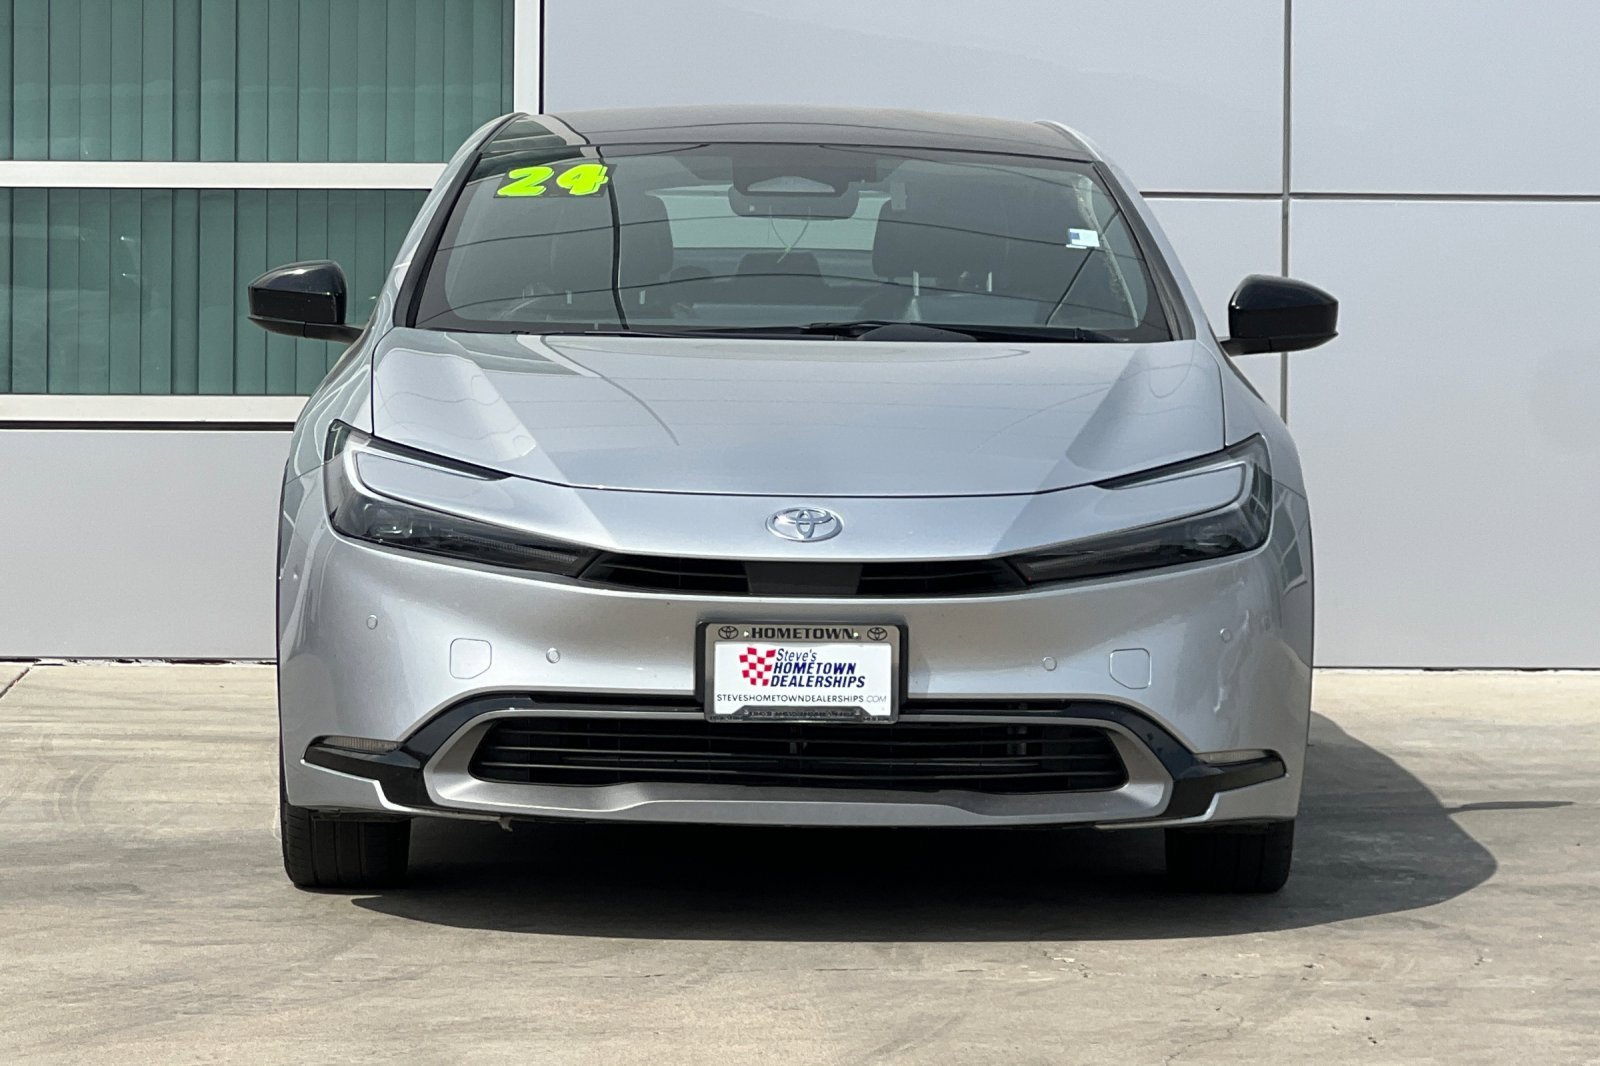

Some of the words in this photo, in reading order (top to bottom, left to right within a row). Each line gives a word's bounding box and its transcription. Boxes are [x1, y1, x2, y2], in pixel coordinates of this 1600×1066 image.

[497, 164, 609, 196] 24
[751, 628, 855, 640] HOMETOWN
[776, 648, 818, 662] Steve's
[773, 662, 856, 675] HOMETOWN
[770, 675, 866, 688] DEALERSHIPS
[716, 693, 887, 703] STEVESHOMETOWNDEALERSHIPSCOM
